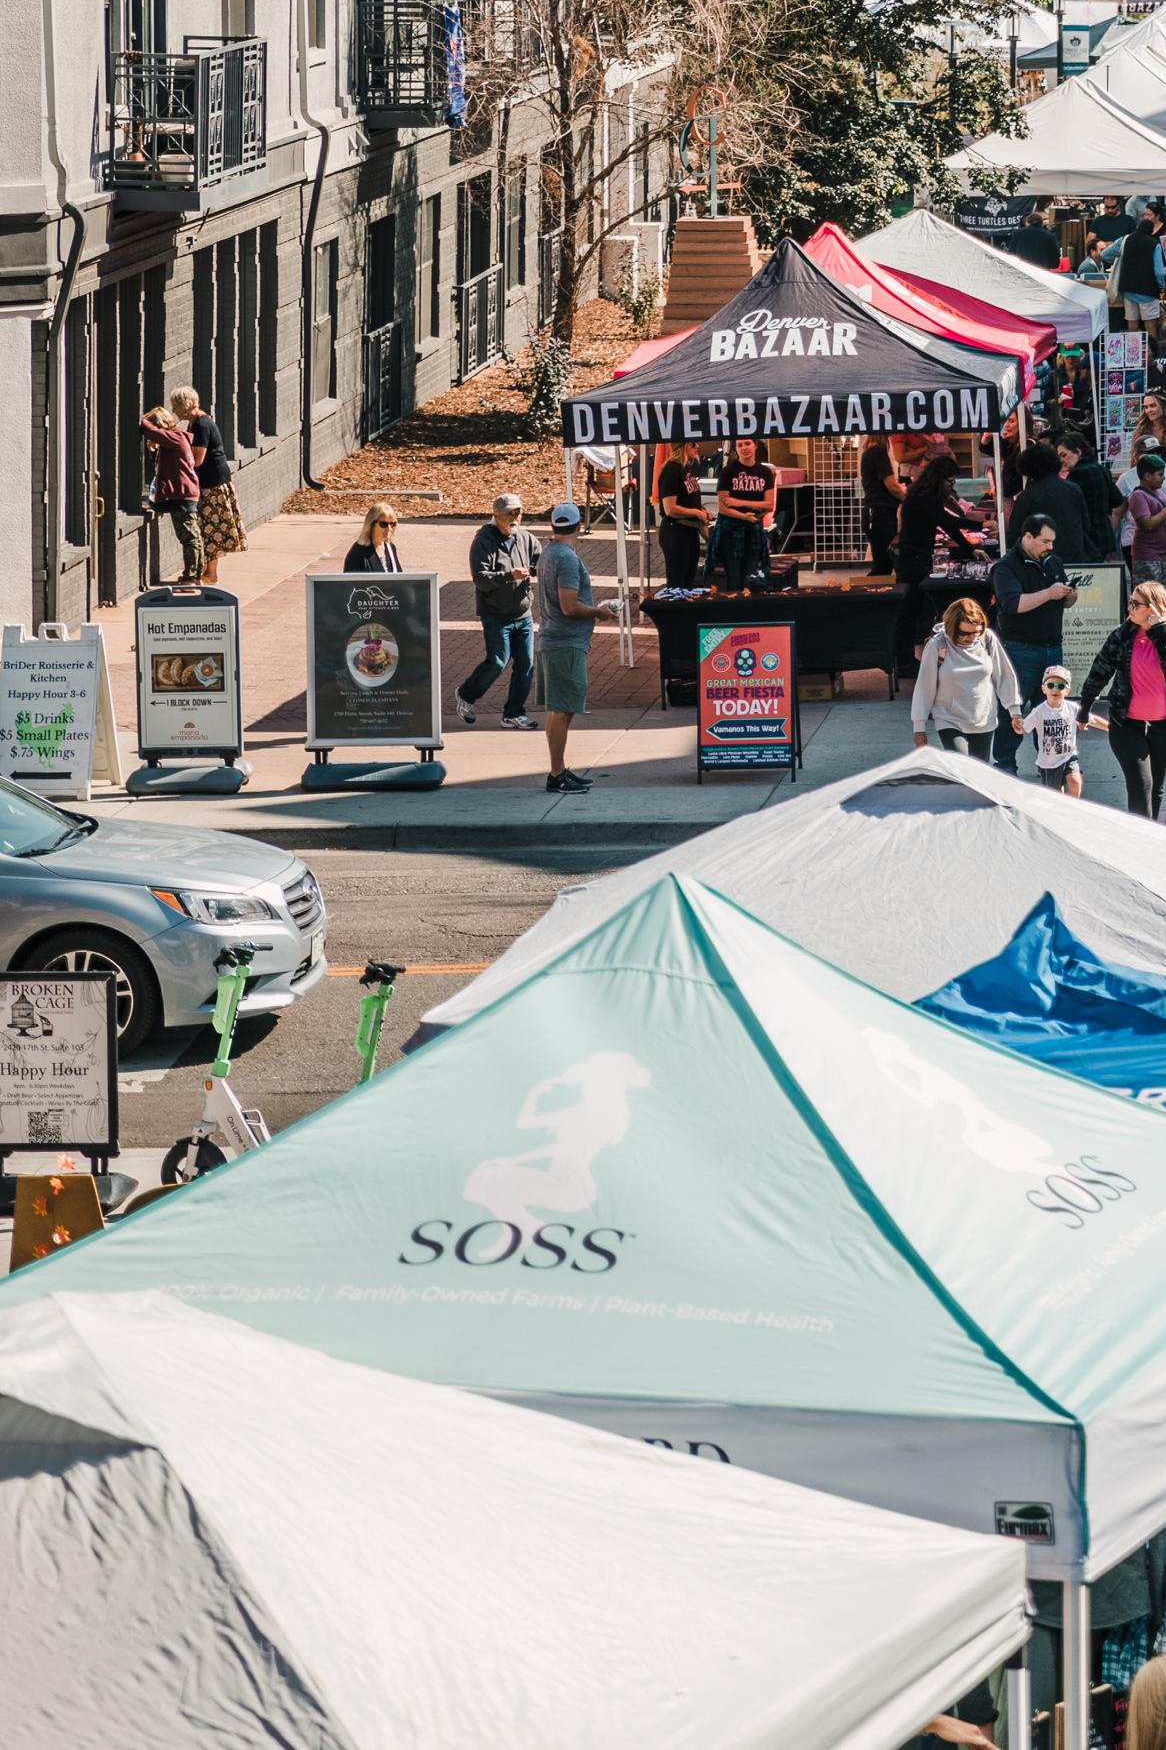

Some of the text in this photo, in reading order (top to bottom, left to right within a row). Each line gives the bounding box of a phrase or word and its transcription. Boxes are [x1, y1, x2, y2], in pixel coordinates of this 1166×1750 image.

[960, 214, 1023, 226] THREE TURTLES DES
[736, 308, 832, 335] Denver
[709, 322, 858, 362] BAZAAR
[572, 388, 990, 444] DENVERBAZAAR.COM
[147, 622, 227, 635] Hot Empanadas
[701, 628, 720, 646] FREE
[704, 630, 726, 653] ENTRY
[3, 660, 94, 670] BriDer Rotisserie &
[30, 674, 67, 682] Kitchen
[8, 690, 86, 700] Happy Hour 3-6
[706, 687, 785, 699] BEER FIESTA
[166, 699, 169, 707] 1
[170, 699, 190, 707] BLOCK
[713, 699, 778, 715] TODAY!
[16, 712, 75, 725] $5 Drinks
[0, 728, 89, 742] $5 Small Plates
[1043, 725, 1071, 737] MARVEL
[10, 746, 75, 760] $.75 Wings
[12, 984, 74, 996] BROKEN
[35, 997, 74, 1009] CAGE
[0, 1062, 89, 1080] Happy Hour
[227, 1115, 244, 1144] On Lime
[1026, 1155, 1137, 1230] SOSS
[219, 1284, 312, 1304] Organic
[334, 1284, 509, 1305] Family-Owned
[512, 1288, 587, 1311] Farms
[604, 1297, 750, 1325] Plant-Based
[754, 1311, 834, 1334] Health
